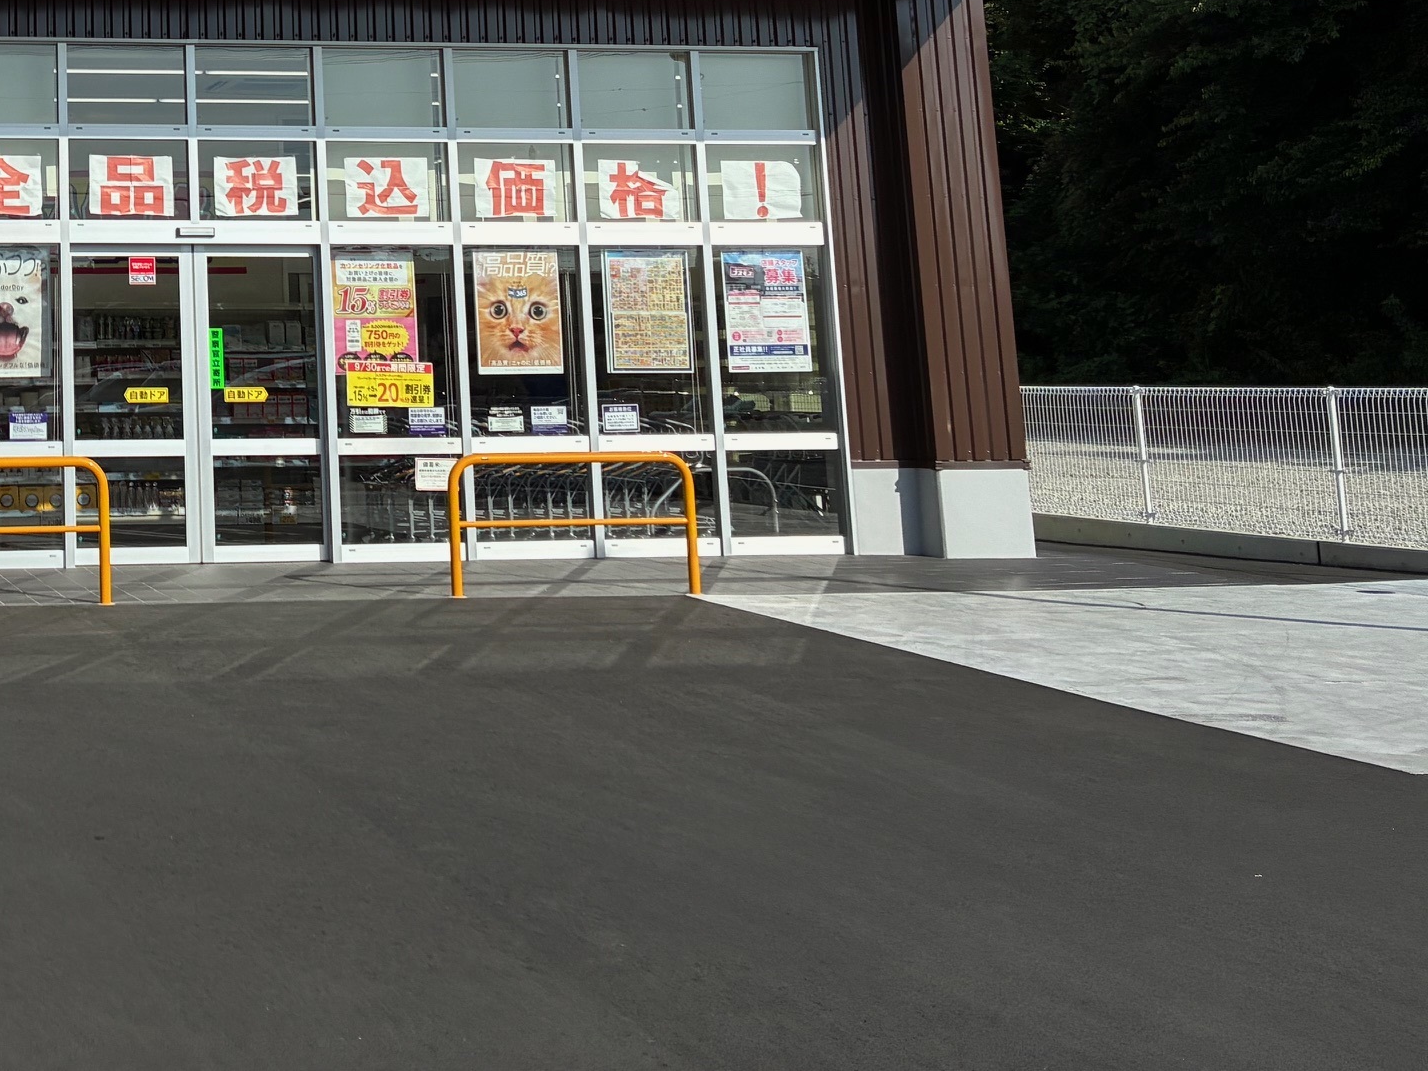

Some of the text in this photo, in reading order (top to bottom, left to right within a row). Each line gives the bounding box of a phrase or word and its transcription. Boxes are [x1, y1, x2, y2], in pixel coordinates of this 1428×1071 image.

[765, 268, 797, 284] 募集
[129, 391, 165, 400] 自動ドア
[227, 390, 263, 399] 自動ドア
